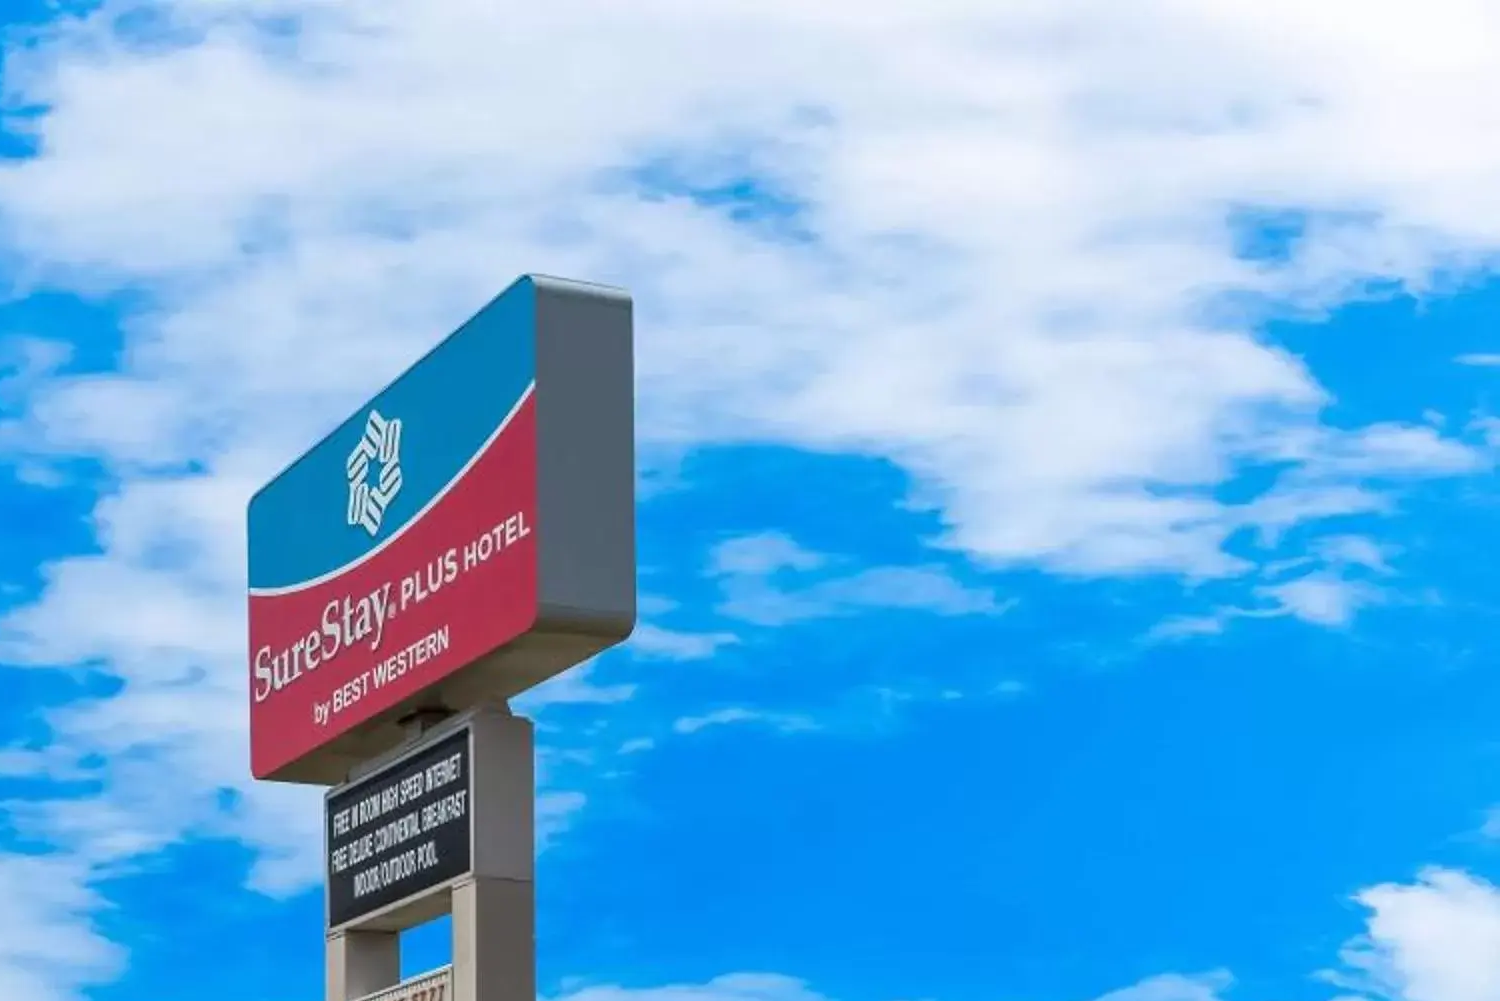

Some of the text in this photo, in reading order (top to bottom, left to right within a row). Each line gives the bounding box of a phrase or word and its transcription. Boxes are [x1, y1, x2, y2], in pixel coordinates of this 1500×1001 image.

[401, 548, 458, 611] PLUS
[464, 511, 531, 572] HOTEL
[314, 624, 450, 727] by BEST WESTERN
[331, 789, 467, 874] FREE DELUXE CONTINENTAL BREAKFAST
[333, 752, 462, 839] FREE IN ROOM HIGH SPEED INTERNET
[417, 840, 439, 872] POOL
